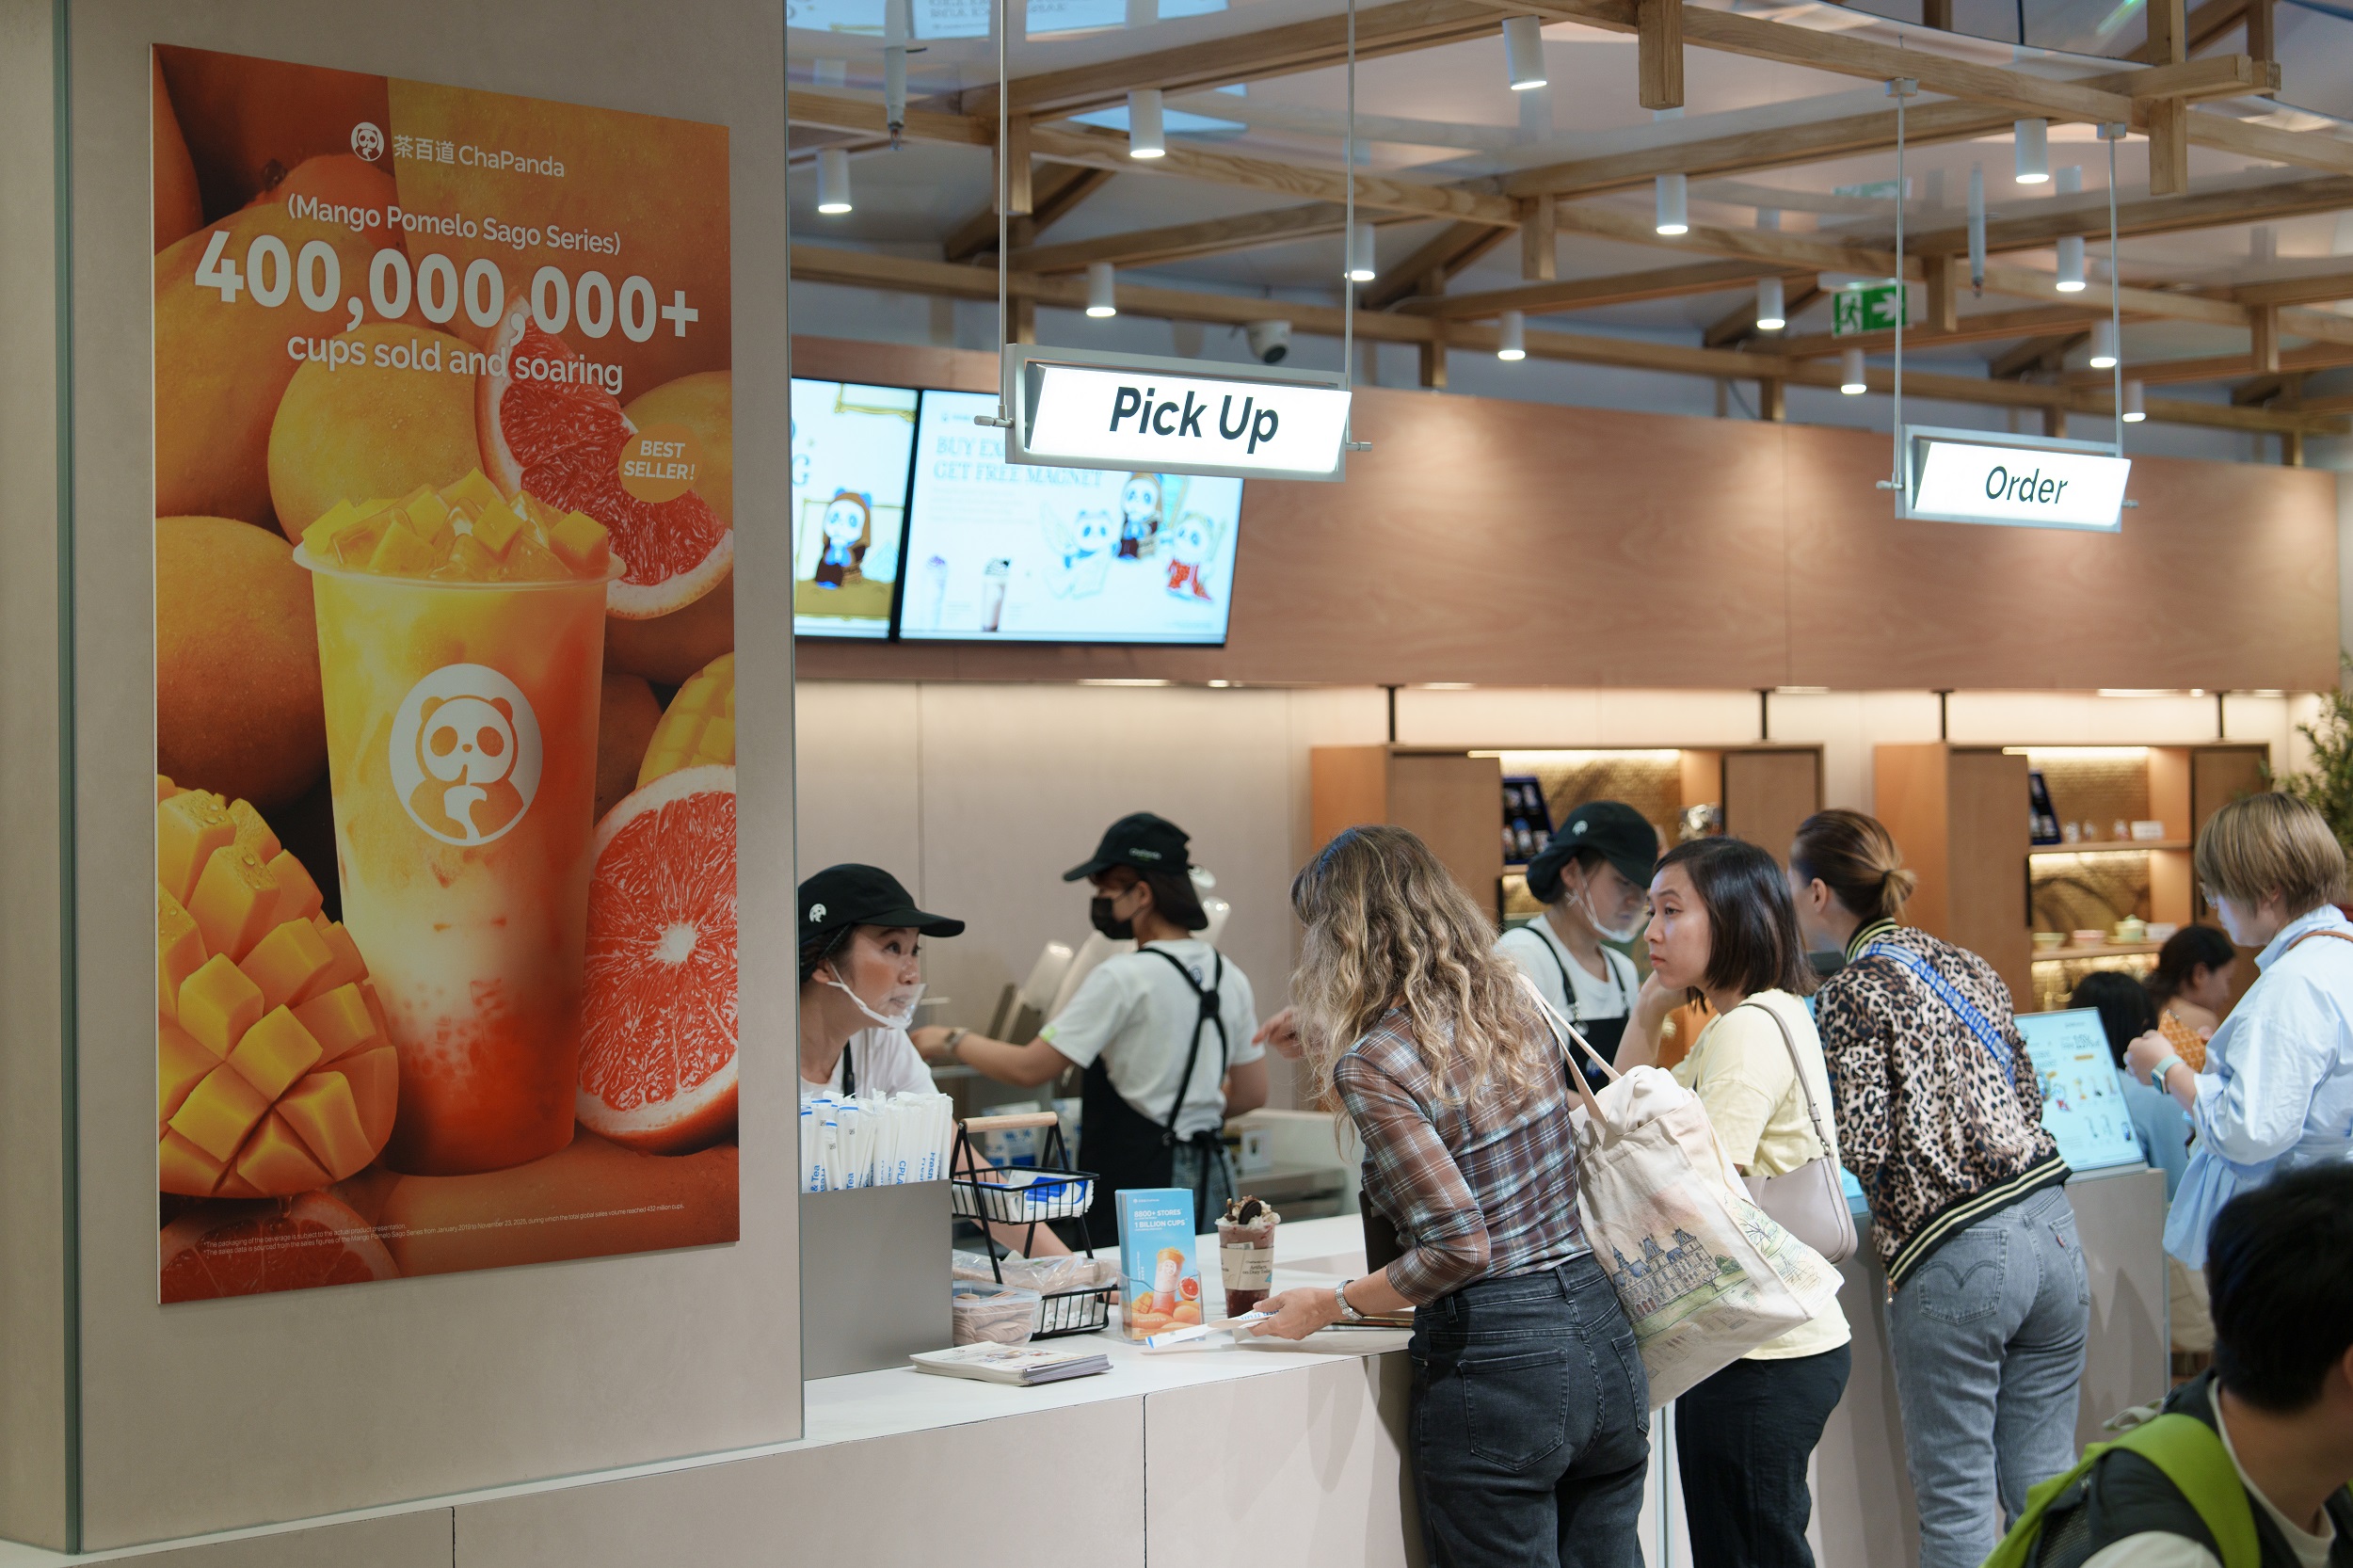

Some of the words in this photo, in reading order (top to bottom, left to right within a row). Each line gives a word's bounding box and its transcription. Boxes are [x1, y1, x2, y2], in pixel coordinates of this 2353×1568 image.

[393, 135, 455, 165] 茶百道
[458, 144, 566, 178] ChaPanda
[287, 191, 381, 232] (Mango
[387, 204, 477, 241] Pomelo
[482, 216, 541, 251] Sago
[546, 223, 621, 256] Series)
[194, 230, 700, 345] 400,000,000+
[287, 334, 366, 373] cups
[374, 338, 442, 373] sold
[449, 345, 508, 379] and
[515, 351, 624, 396] soaring
[1109, 386, 1209, 439] Pick
[1218, 393, 1280, 455] Up
[640, 440, 686, 460] BEST
[624, 459, 696, 482] SELLER!
[934, 459, 970, 482] GET
[976, 461, 1021, 483] FREE
[1986, 466, 2068, 504] Order
[811, 1165, 820, 1182] Tea
[218, 1239, 248, 1248] packaging
[297, 1231, 317, 1240] subject
[351, 1226, 371, 1236] product
[254, 1243, 276, 1252] sourced
[351, 1234, 369, 1242] Mango
[580, 1212, 594, 1220] global
[1139, 1220, 1166, 1228] BILLION
